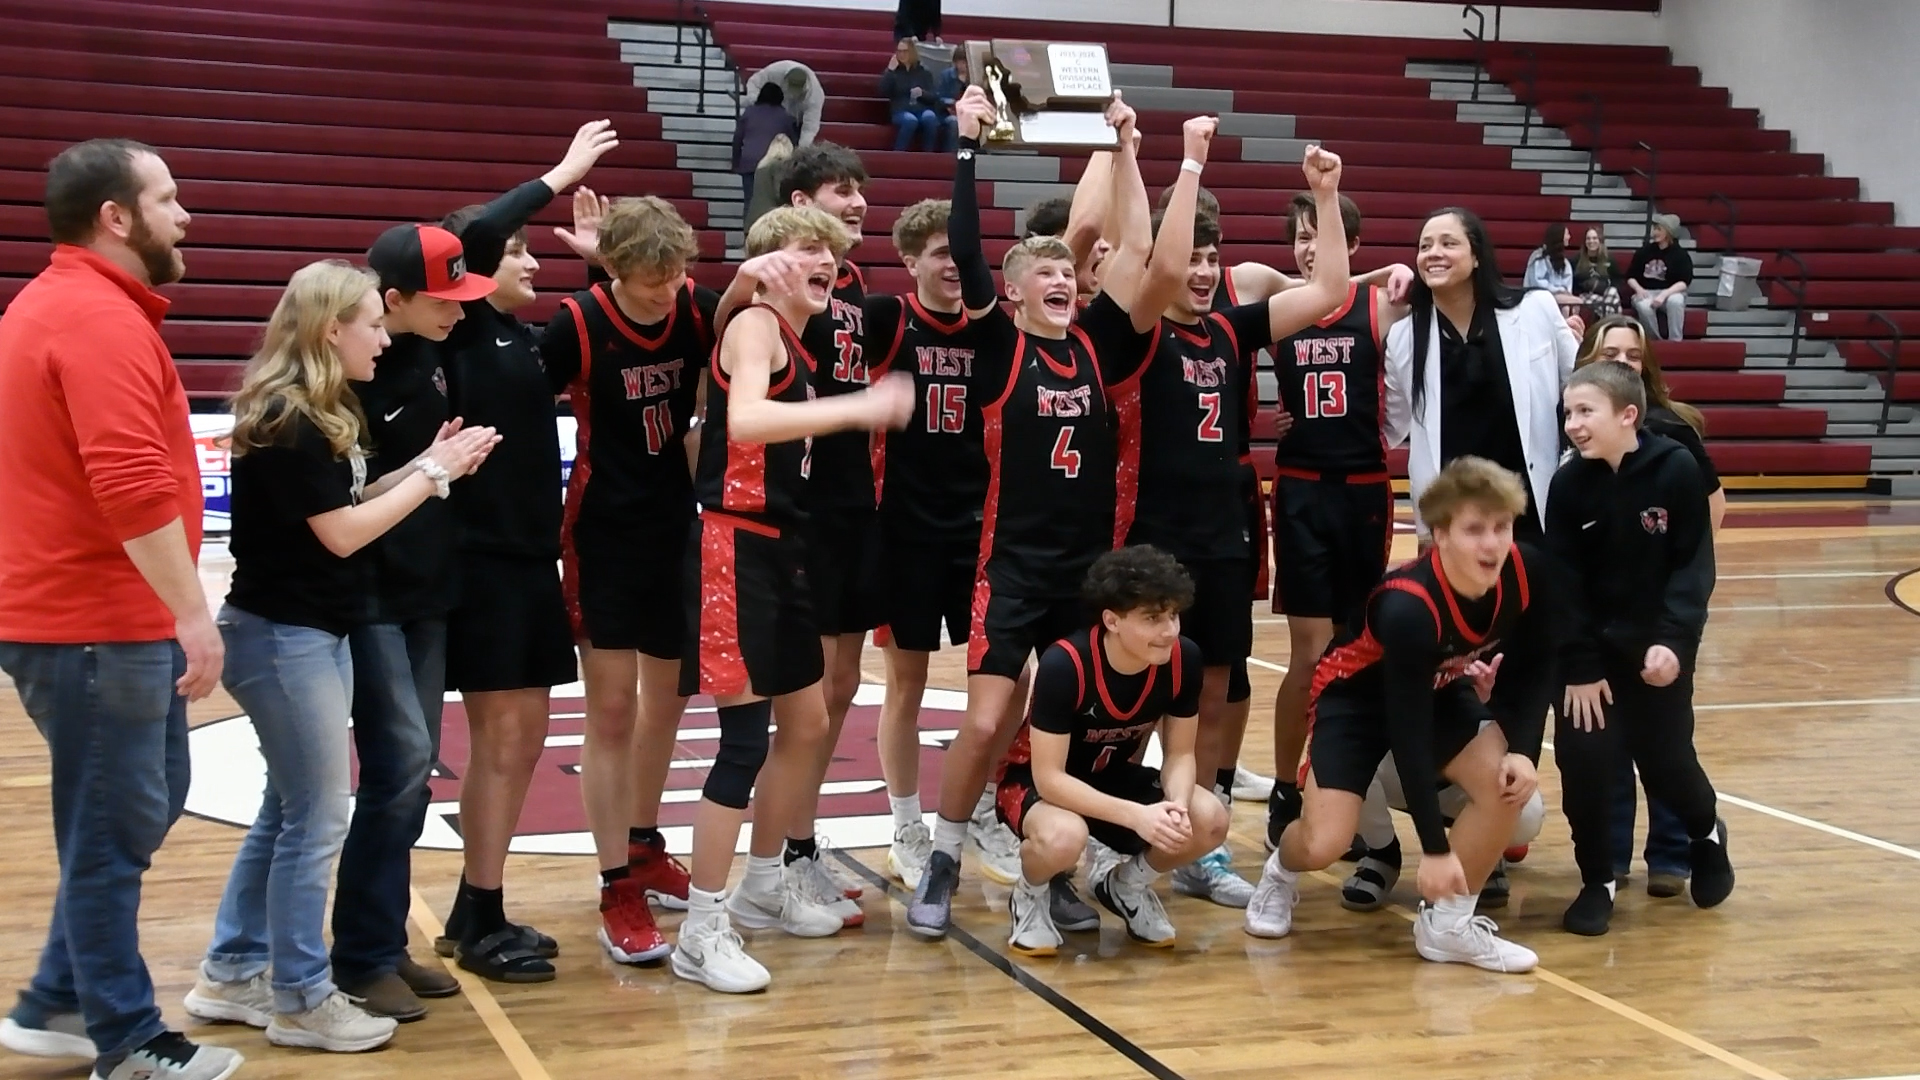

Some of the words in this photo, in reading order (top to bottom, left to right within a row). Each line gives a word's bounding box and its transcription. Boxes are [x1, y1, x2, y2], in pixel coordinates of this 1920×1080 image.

[1059, 74, 1102, 82] DIVISIONAL
[1061, 66, 1099, 74] WESTERN
[915, 346, 975, 377] WEST
[1293, 336, 1355, 366] WEST
[621, 358, 684, 400] WEST
[1180, 354, 1227, 388] WEST
[926, 383, 967, 434] 15
[1037, 384, 1091, 418] WEST
[1303, 371, 1348, 419] 13
[642, 399, 674, 456] 11
[1197, 392, 1223, 442] 2
[1050, 425, 1081, 479] 4
